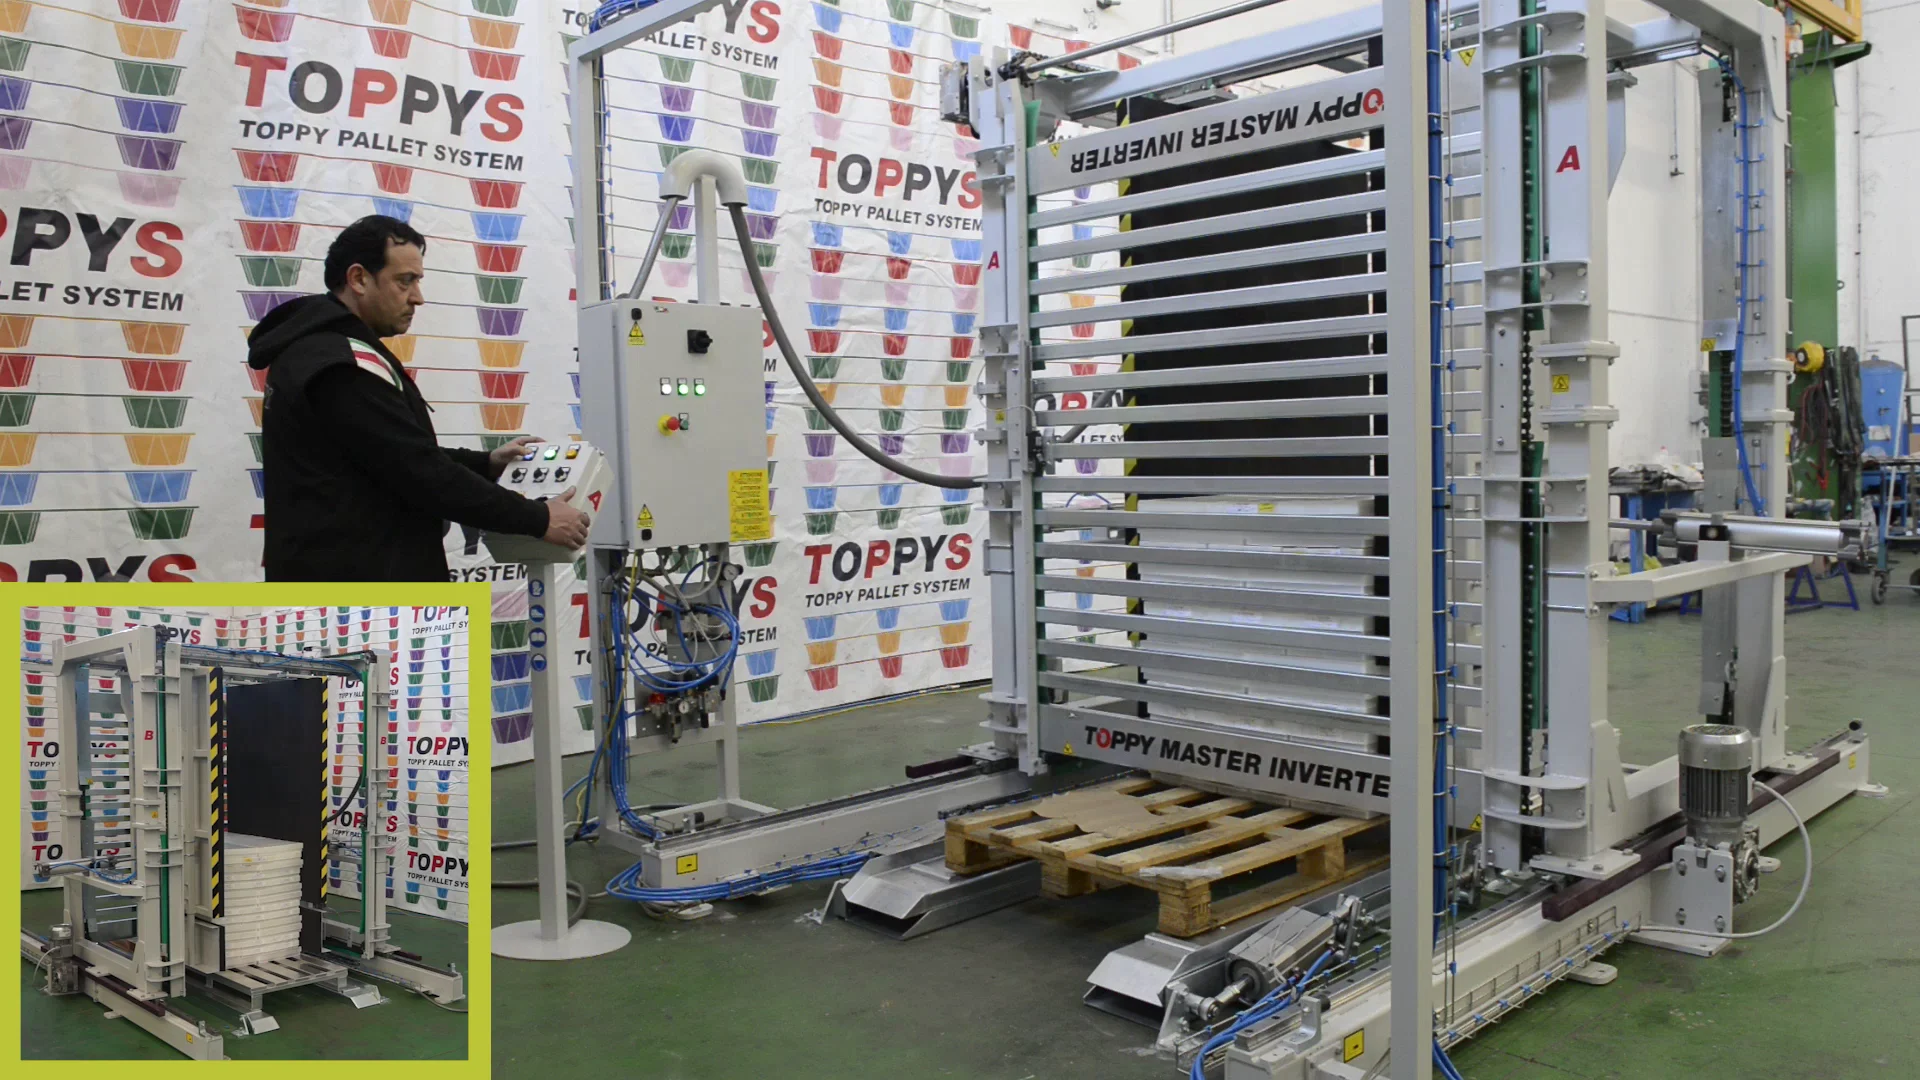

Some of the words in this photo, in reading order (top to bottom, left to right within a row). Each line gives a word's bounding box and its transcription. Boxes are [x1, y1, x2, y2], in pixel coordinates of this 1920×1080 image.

[711, 41, 778, 70] SYSTEM
[235, 51, 525, 142] TOPPYS
[1306, 88, 1384, 126] OPPY
[1191, 105, 1298, 149] MASTER
[239, 120, 329, 145] TOPPY
[338, 129, 428, 157] PALLET
[434, 145, 523, 172] SYSTEM
[1070, 130, 1184, 174] INVERTER
[1556, 145, 1580, 173] A
[810, 147, 983, 210] TOPPYS
[814, 198, 863, 218] TOPPY
[867, 206, 922, 225] PALLET
[987, 250, 1000, 270] A
[63, 285, 184, 312] SYSTEM
[804, 533, 973, 585] TOPPYS
[805, 590, 854, 608] TOPPY
[858, 583, 909, 602] PALLET
[913, 578, 971, 595] SYSTEM
[144, 730, 154, 740] B
[380, 736, 387, 744] B
[1085, 725, 1155, 755] TOPPY
[1159, 739, 1261, 775] MASTER
[428, 876, 453, 886] PALLET
